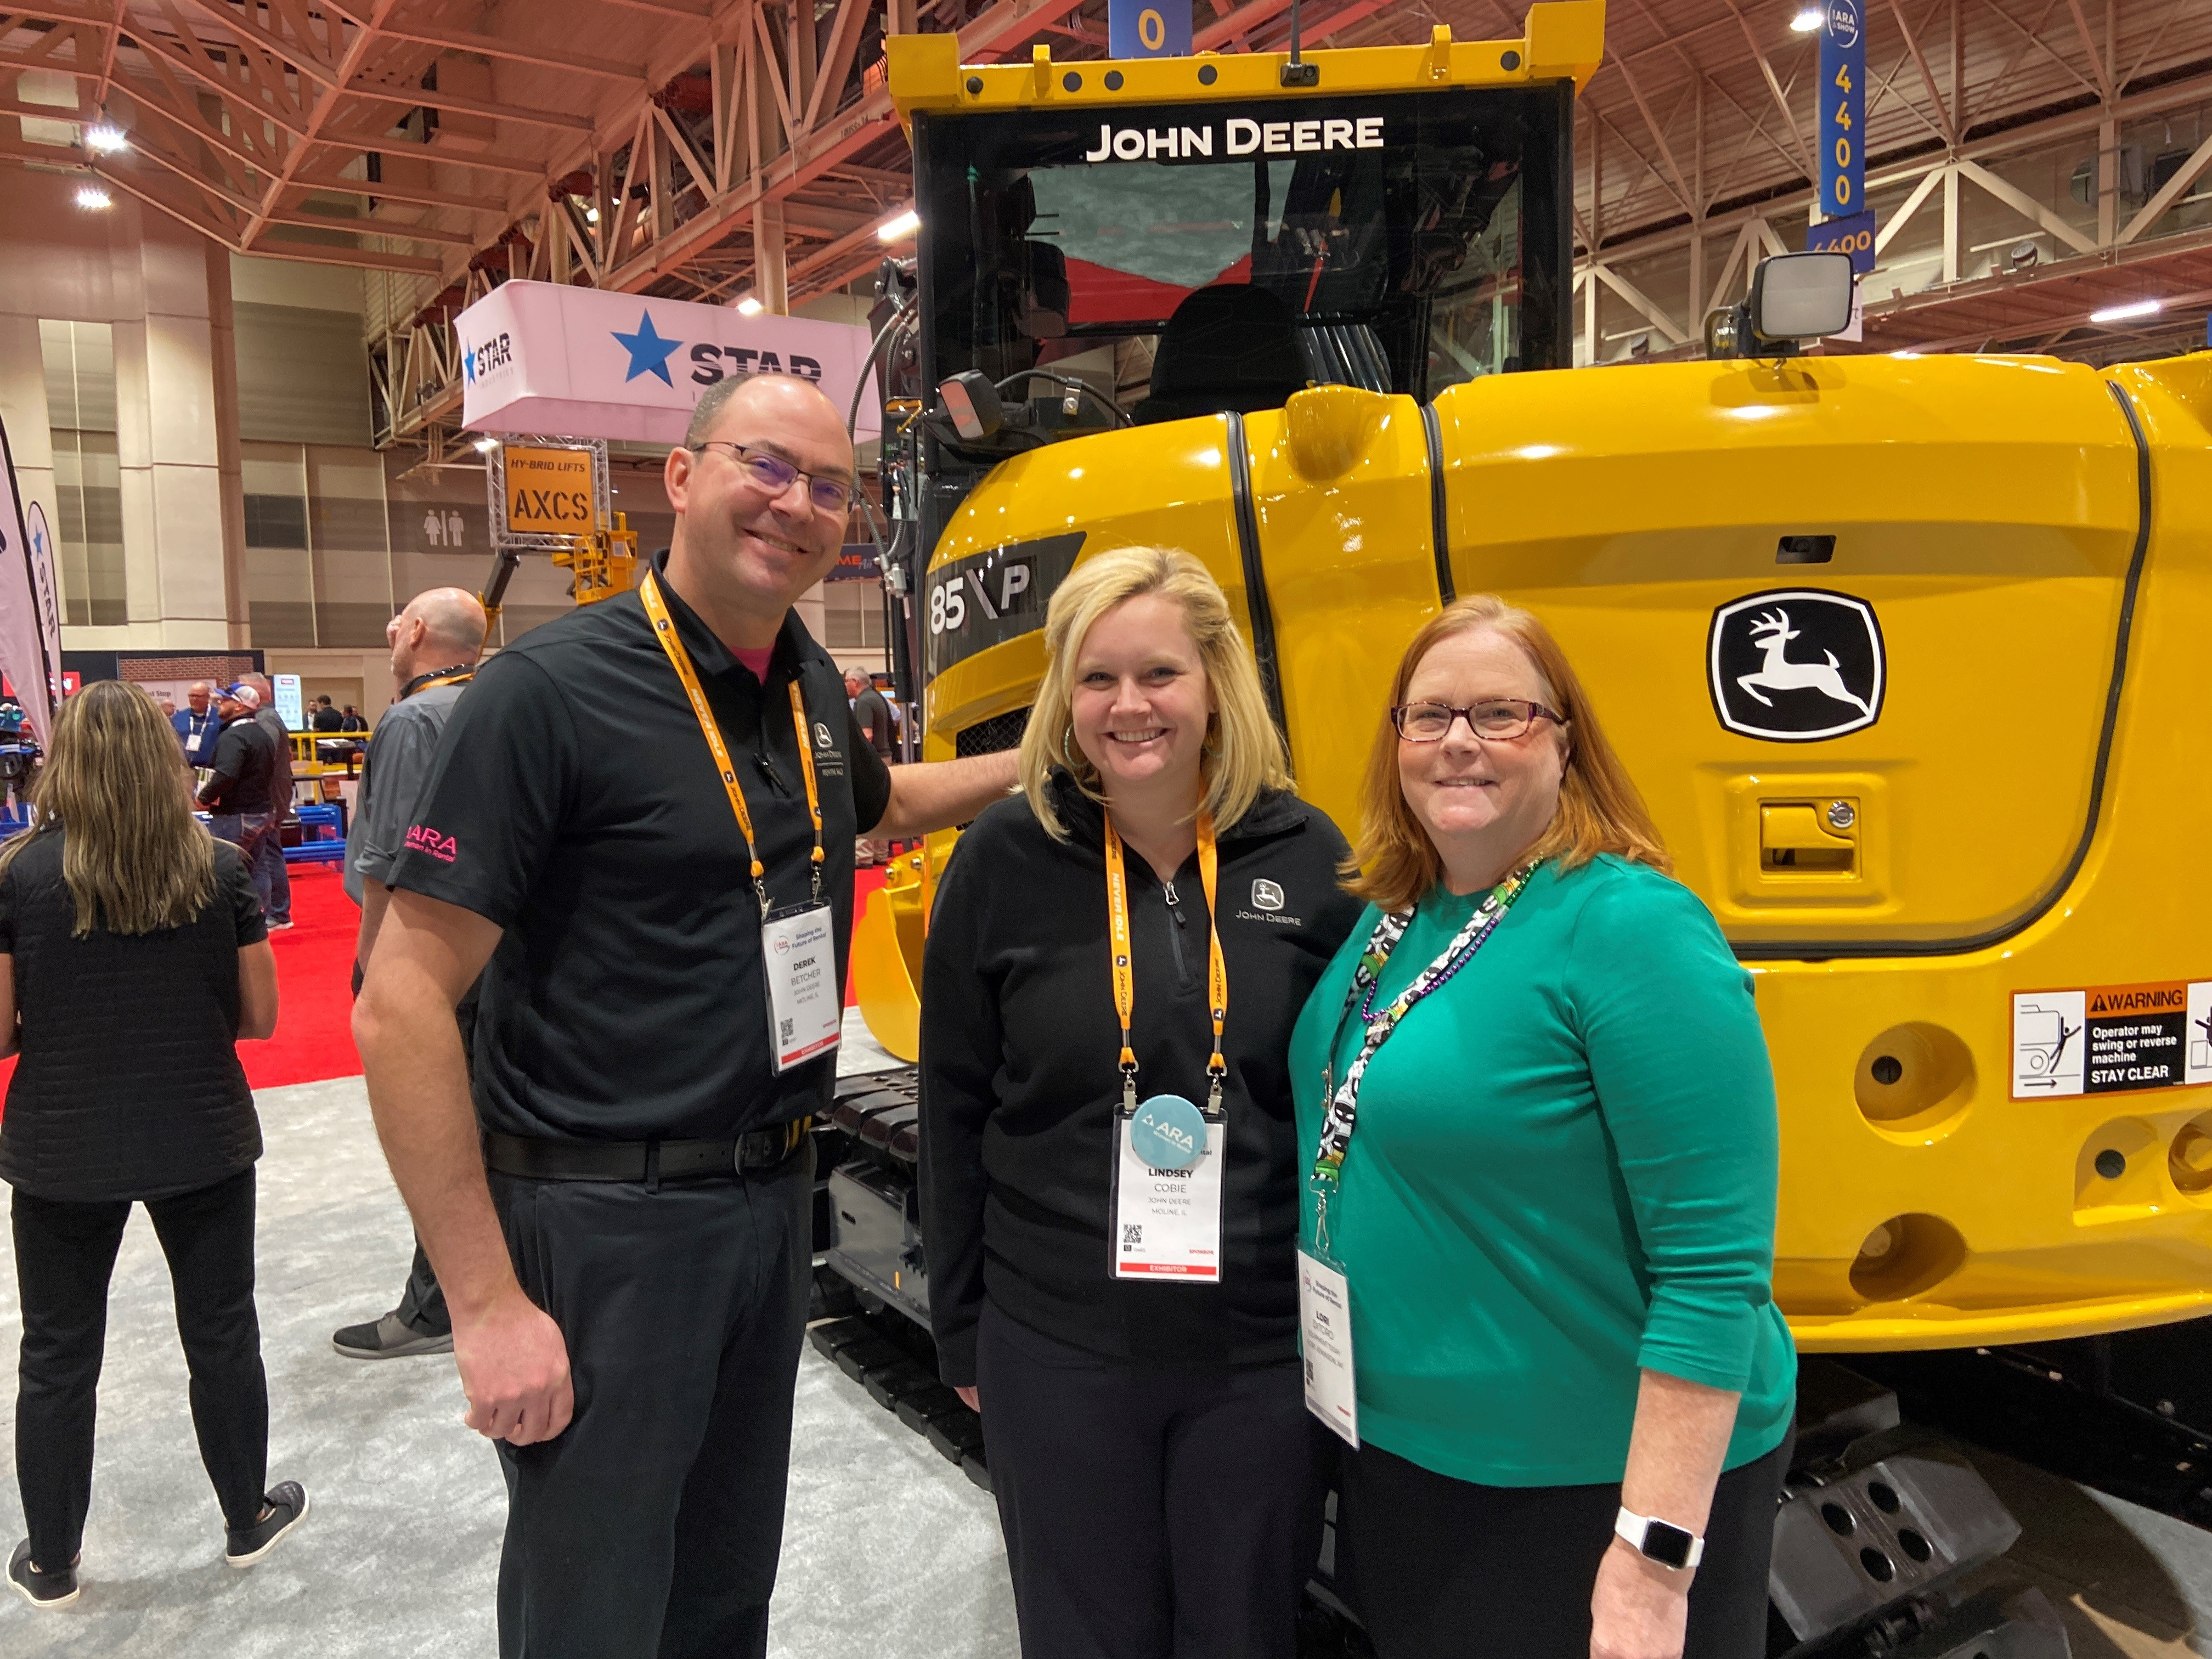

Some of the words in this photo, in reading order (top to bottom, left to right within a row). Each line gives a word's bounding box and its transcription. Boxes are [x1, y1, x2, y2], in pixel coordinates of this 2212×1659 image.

[1836, 10, 1855, 26] ARA
[1837, 22, 1855, 34] SHOW
[1086, 125, 1211, 162] JOHN
[1227, 117, 1384, 155] DEERE
[1835, 64, 1852, 205] 4400
[477, 332, 512, 376] STAR
[511, 459, 554, 470] HY-BRID
[557, 462, 585, 472] LIFTS
[514, 489, 588, 521] AXCS
[931, 577, 965, 634] 85
[1111, 872, 1122, 913] NEVER
[1235, 910, 1265, 921] JOHN
[1266, 913, 1301, 926] DEERE
[1114, 914, 1124, 940] IDLE
[793, 956, 816, 970] DEREK
[791, 968, 821, 986] BETCHER
[2108, 990, 2183, 1010] WARNING
[2092, 1026, 2139, 1040] Operator
[2141, 1025, 2163, 1036] may
[2092, 1040, 2123, 1052] swing
[2126, 1040, 2137, 1048] or
[2140, 1036, 2177, 1048] reverse
[2092, 1052, 2136, 1064] machine
[2091, 1069, 2125, 1084] STAY
[2128, 1065, 2169, 1081] CLEAR
[1156, 1122, 1193, 1149] ARA
[1149, 1168, 1193, 1178] LINDSEY
[1155, 1183, 1187, 1193] COBIE
[1150, 1265, 1187, 1273] EXHIBITOR
